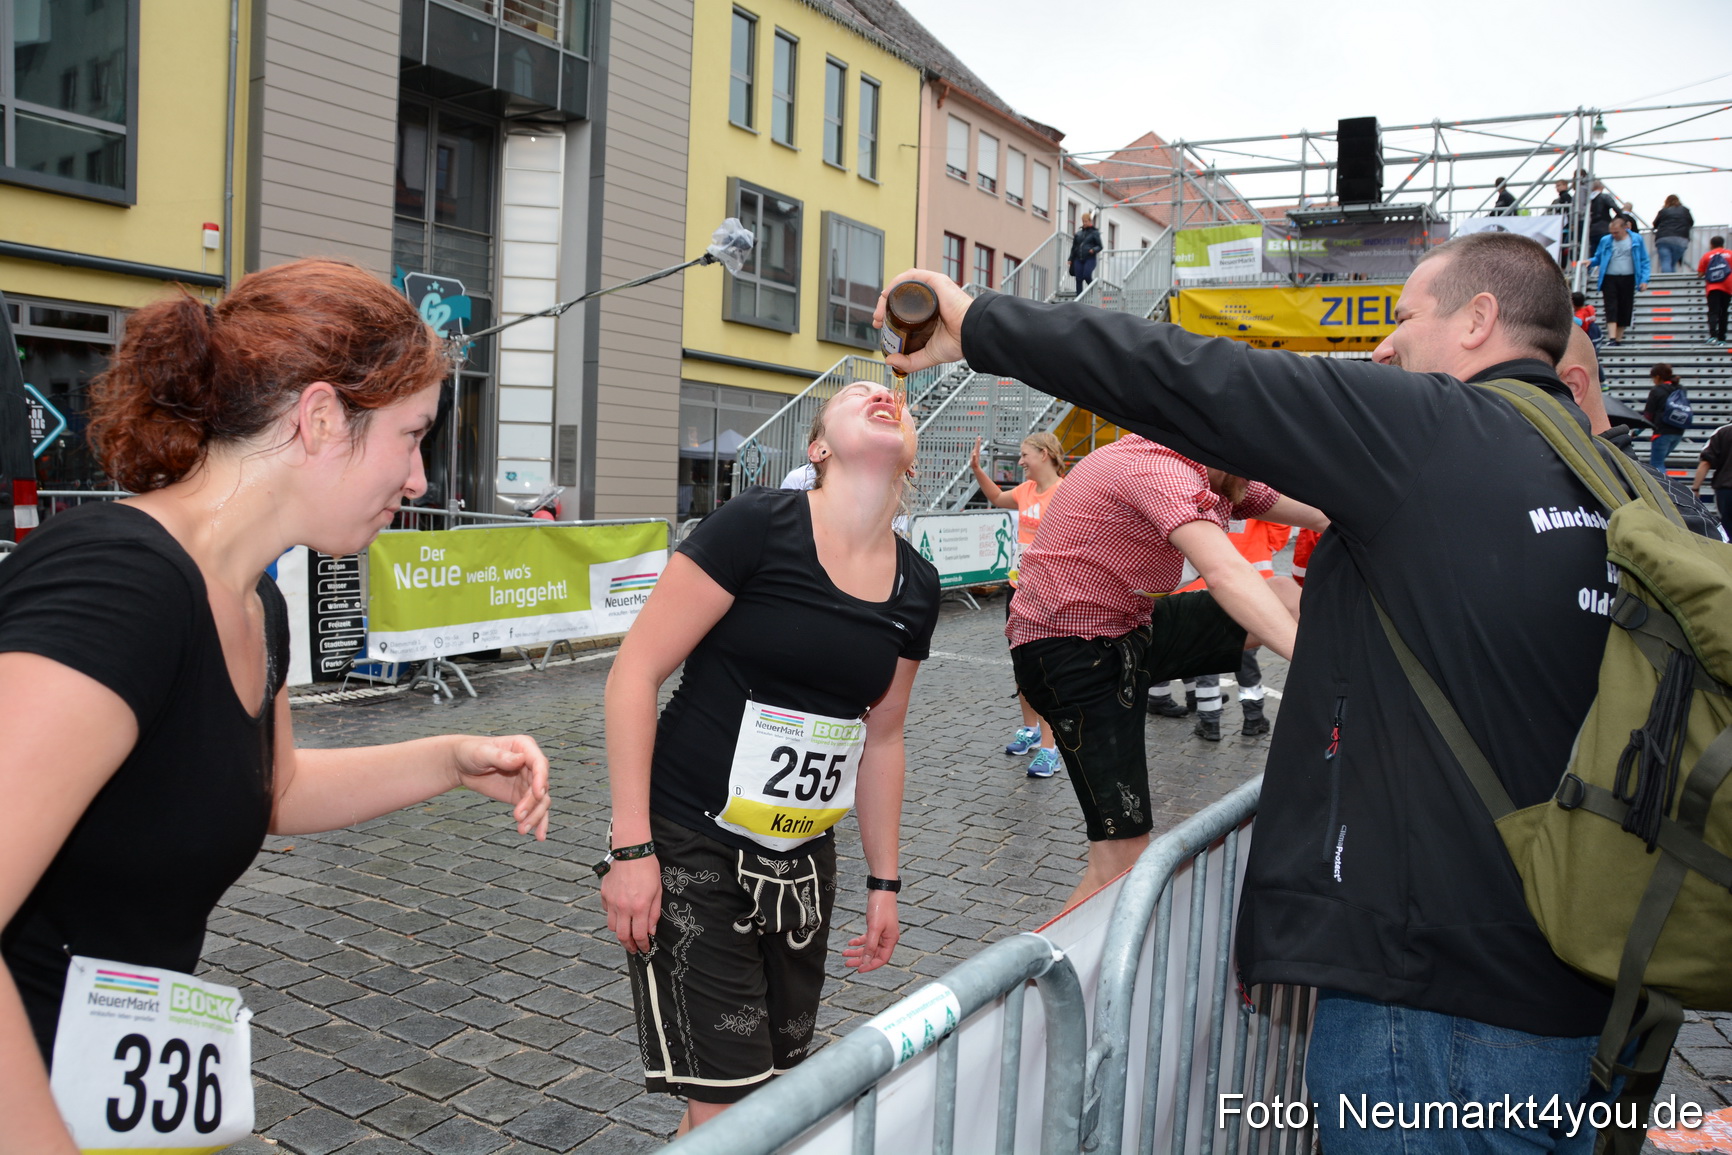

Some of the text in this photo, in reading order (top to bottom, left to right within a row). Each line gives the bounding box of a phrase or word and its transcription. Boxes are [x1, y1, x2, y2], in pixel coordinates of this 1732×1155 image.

[1267, 238, 1328, 252] BOCK
[1200, 313, 1238, 322] Neumarkter
[1320, 296, 1395, 326] ZIEL
[420, 546, 446, 562] Der
[394, 562, 461, 590] Neue
[466, 566, 500, 583] weiß,
[490, 580, 567, 608] langgeht!
[604, 593, 648, 608] NeuerMa
[328, 620, 352, 629] Freizeit
[323, 640, 358, 649] Stadtbusse
[755, 720, 861, 741] NeuerMarkt BOCK
[762, 745, 847, 802] 255
[770, 813, 814, 834] Karin
[88, 982, 236, 1024] NeuerMarkt BOCK
[106, 1033, 223, 1135] 336
